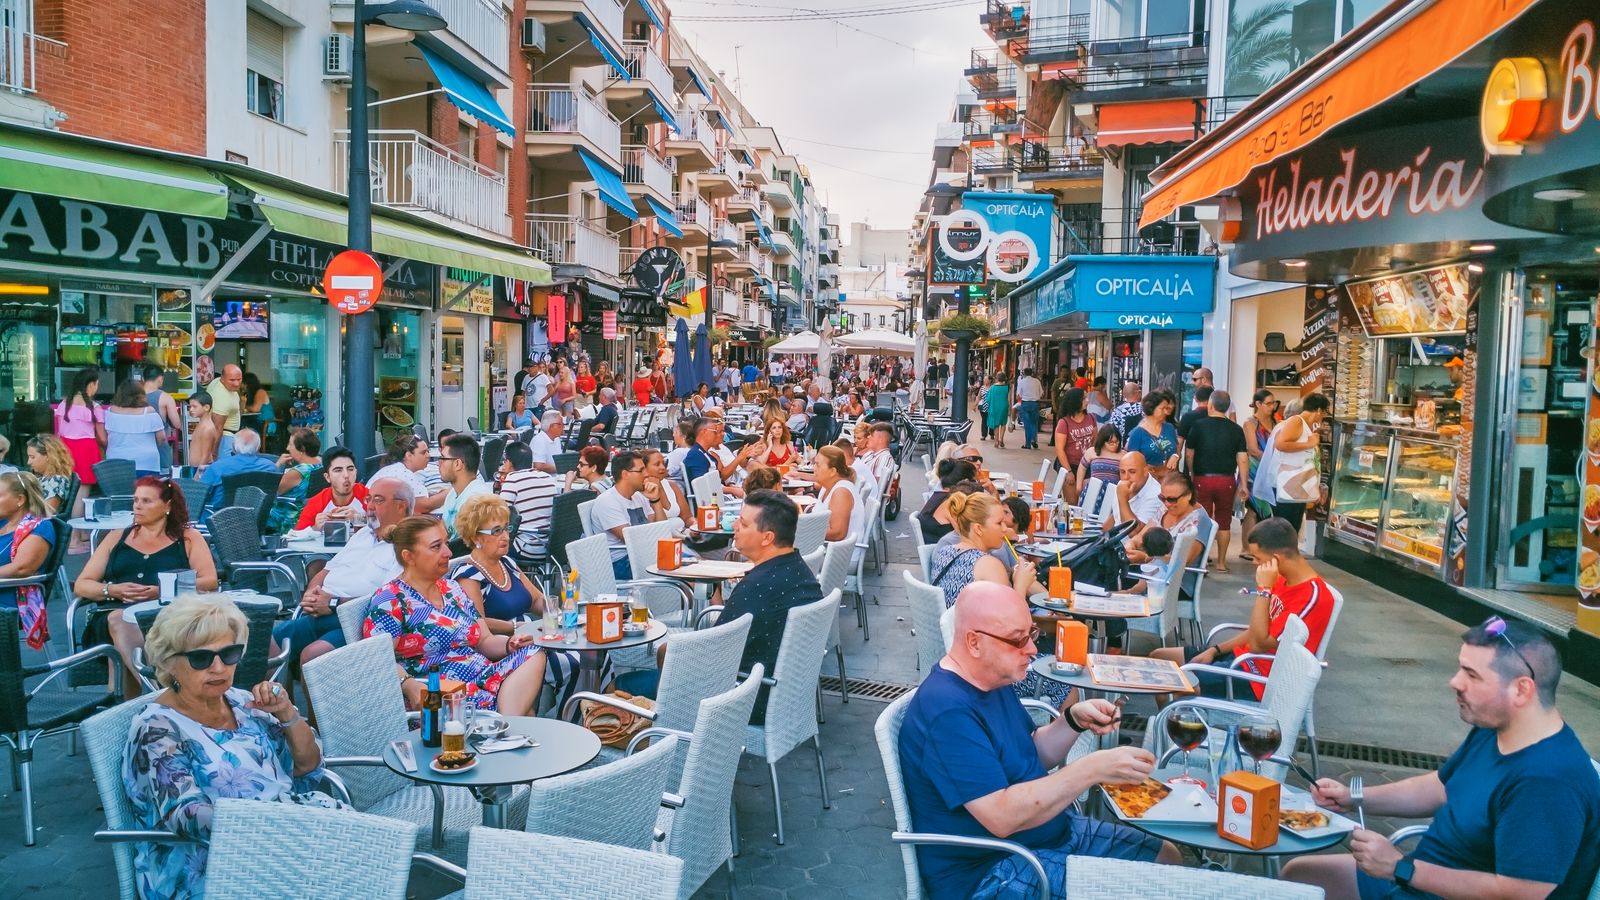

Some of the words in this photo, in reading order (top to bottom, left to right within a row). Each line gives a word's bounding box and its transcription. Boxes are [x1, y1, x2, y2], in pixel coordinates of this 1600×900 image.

[1299, 95, 1334, 136] Bar
[1257, 146, 1484, 241] Heladería
[1095, 273, 1194, 301] OPTICALiA
[1118, 312, 1174, 328] OPTICALiA
